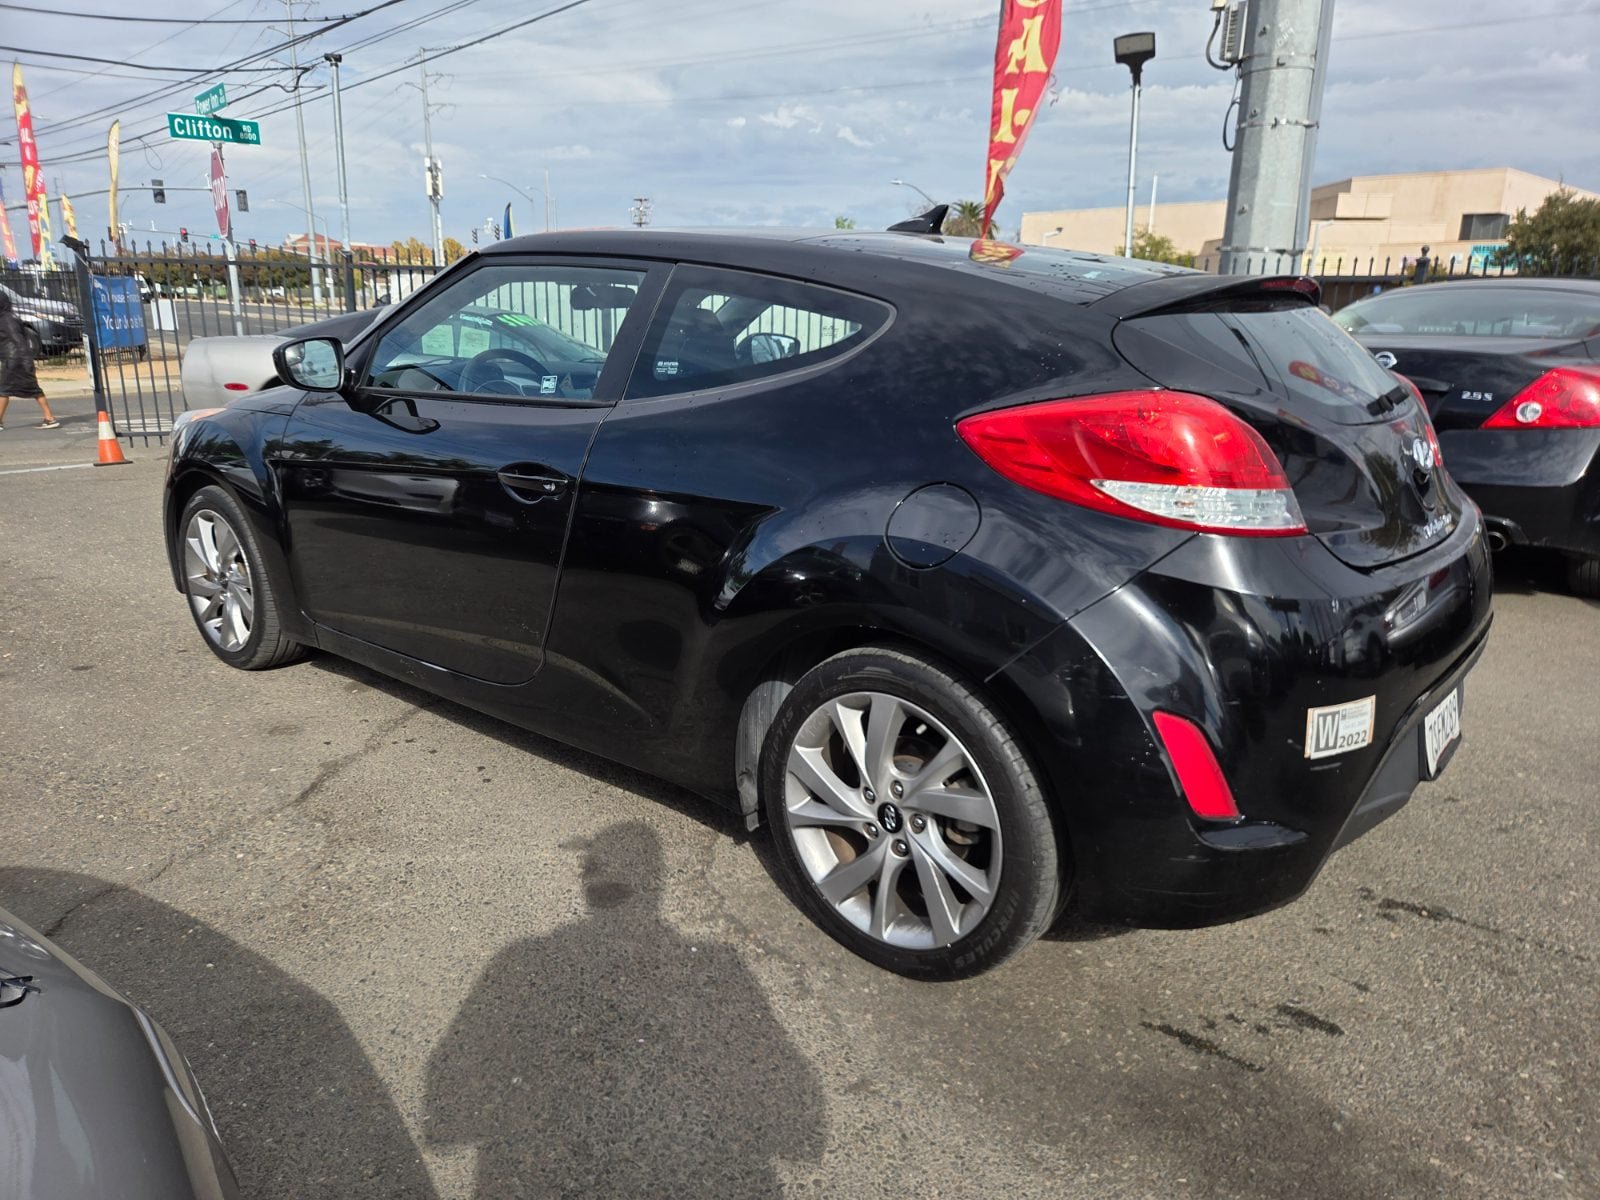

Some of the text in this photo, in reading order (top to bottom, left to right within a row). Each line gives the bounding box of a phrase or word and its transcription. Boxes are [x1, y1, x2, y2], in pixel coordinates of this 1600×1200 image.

[174, 117, 233, 139] Clifton
[1318, 713, 1339, 749] W
[1338, 729, 1368, 749] 2022
